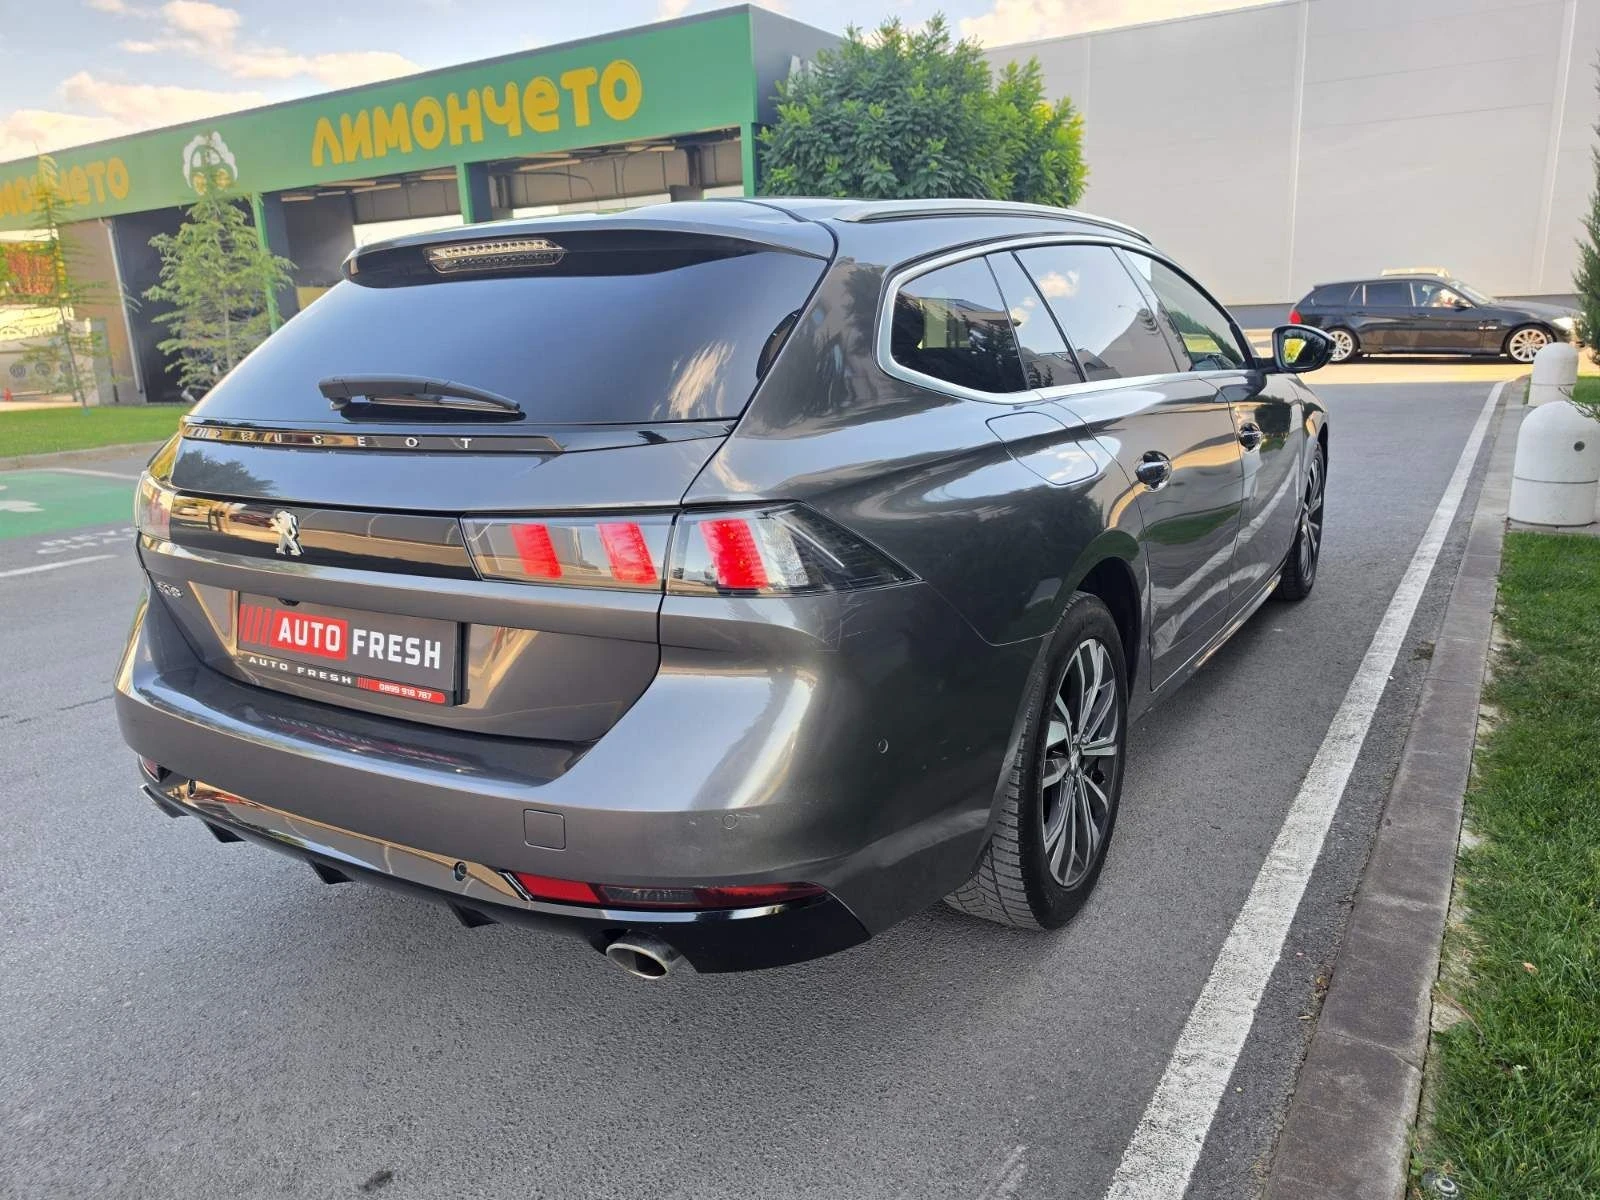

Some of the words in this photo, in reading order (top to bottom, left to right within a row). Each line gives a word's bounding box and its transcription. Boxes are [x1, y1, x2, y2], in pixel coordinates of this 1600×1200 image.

[278, 617, 341, 653] AUTO
[351, 628, 441, 670] FRESH
[249, 656, 290, 672] AUTO
[297, 666, 352, 685] FRESH
[417, 690, 432, 700] 787
